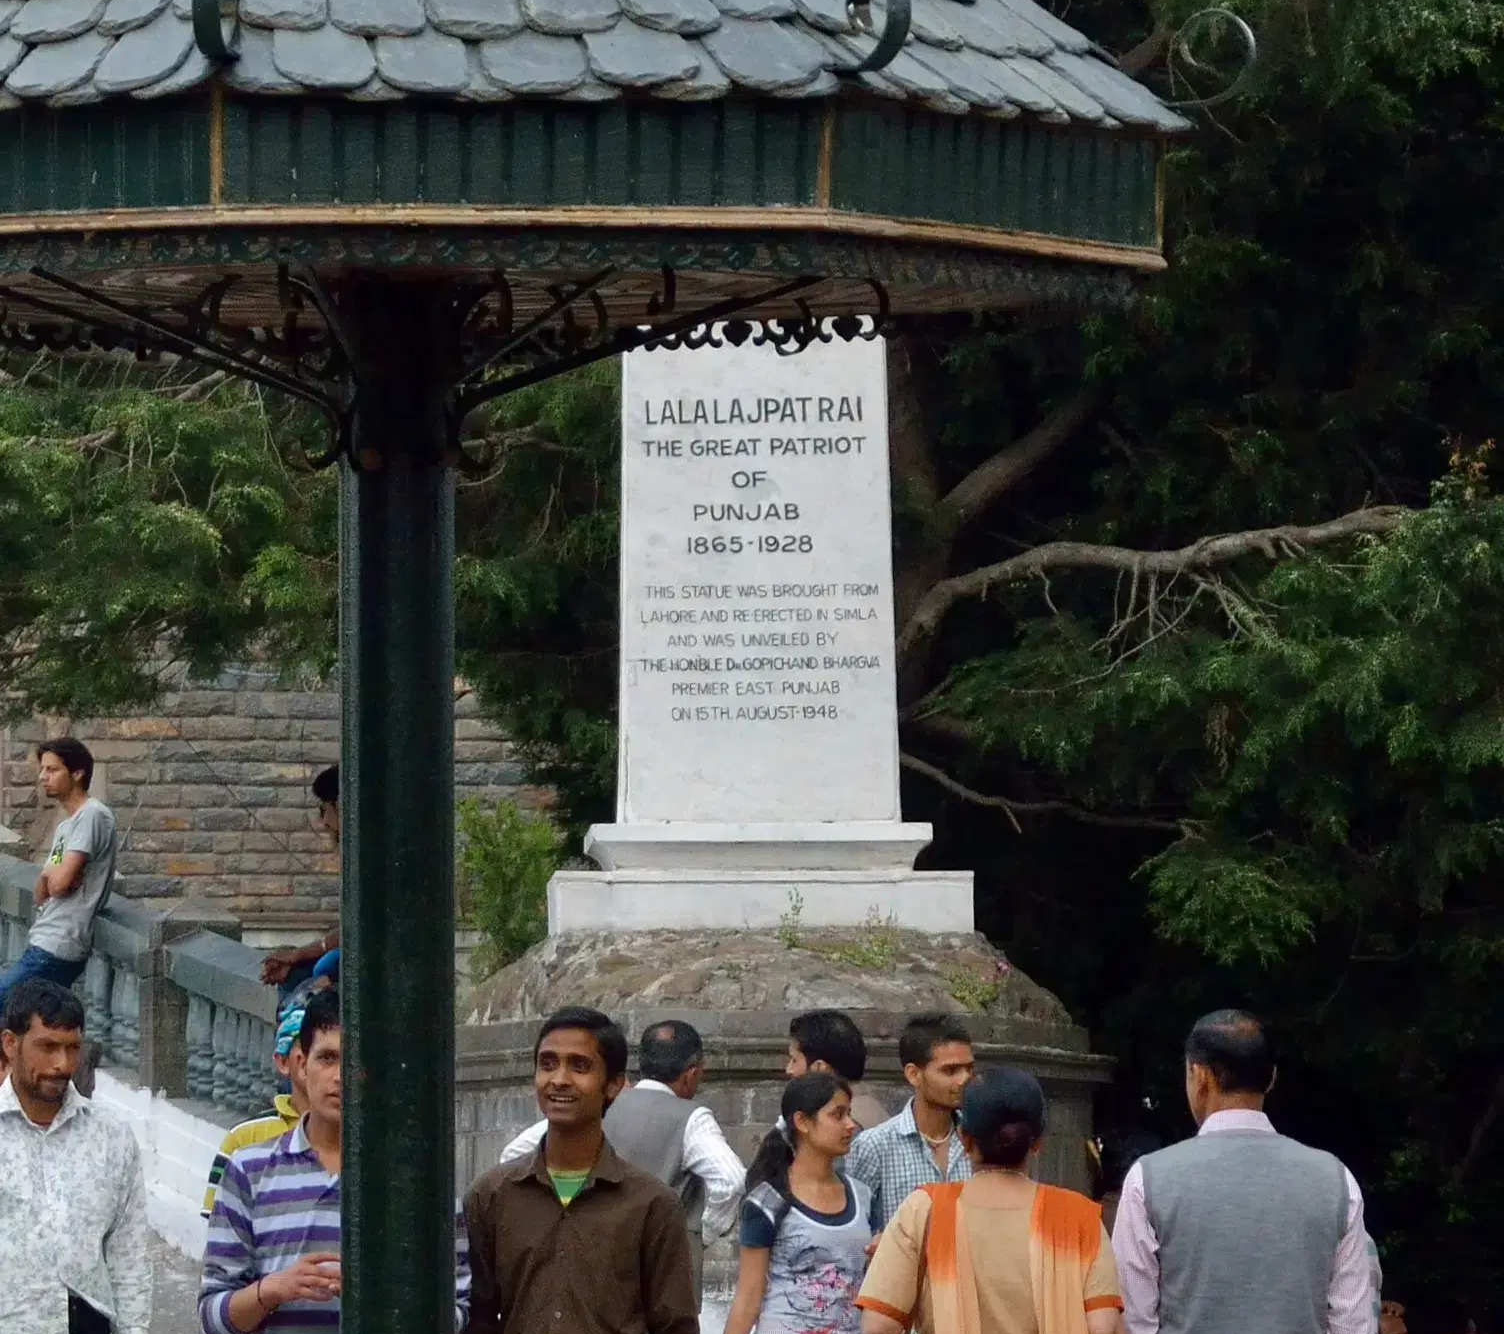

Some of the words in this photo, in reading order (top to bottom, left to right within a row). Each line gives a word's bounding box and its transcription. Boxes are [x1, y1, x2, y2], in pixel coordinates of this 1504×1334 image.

[645, 399, 709, 425] LALA
[713, 397, 813, 424] LAJPAT
[818, 396, 864, 422] RAI
[642, 440, 683, 457] THE
[690, 438, 761, 457] GREAT
[770, 436, 867, 455] PATRIOT
[731, 470, 767, 488] OF
[693, 503, 800, 521] PUNJAB
[687, 535, 814, 554] 1865-1928
[644, 585, 675, 599] THIS
[681, 585, 732, 599] STATUE
[737, 584, 768, 598] WAS
[772, 584, 838, 597] BROUGHT
[843, 583, 879, 596] FROM
[640, 609, 696, 624] LAHORE
[700, 609, 728, 623] AND
[816, 608, 829, 621] IN
[833, 607, 878, 621] SIMLA
[667, 634, 697, 648] AND
[703, 633, 735, 647] WAS
[741, 632, 810, 647] UNVEILED
[816, 631, 839, 646] BY
[640, 658, 667, 673] THE
[743, 657, 818, 671] GOPICHAND
[823, 656, 880, 668] BHARGVA
[672, 682, 729, 696] PREMIER
[736, 682, 774, 695] EAST
[782, 681, 841, 695] PUNJAB
[671, 707, 691, 721] ON
